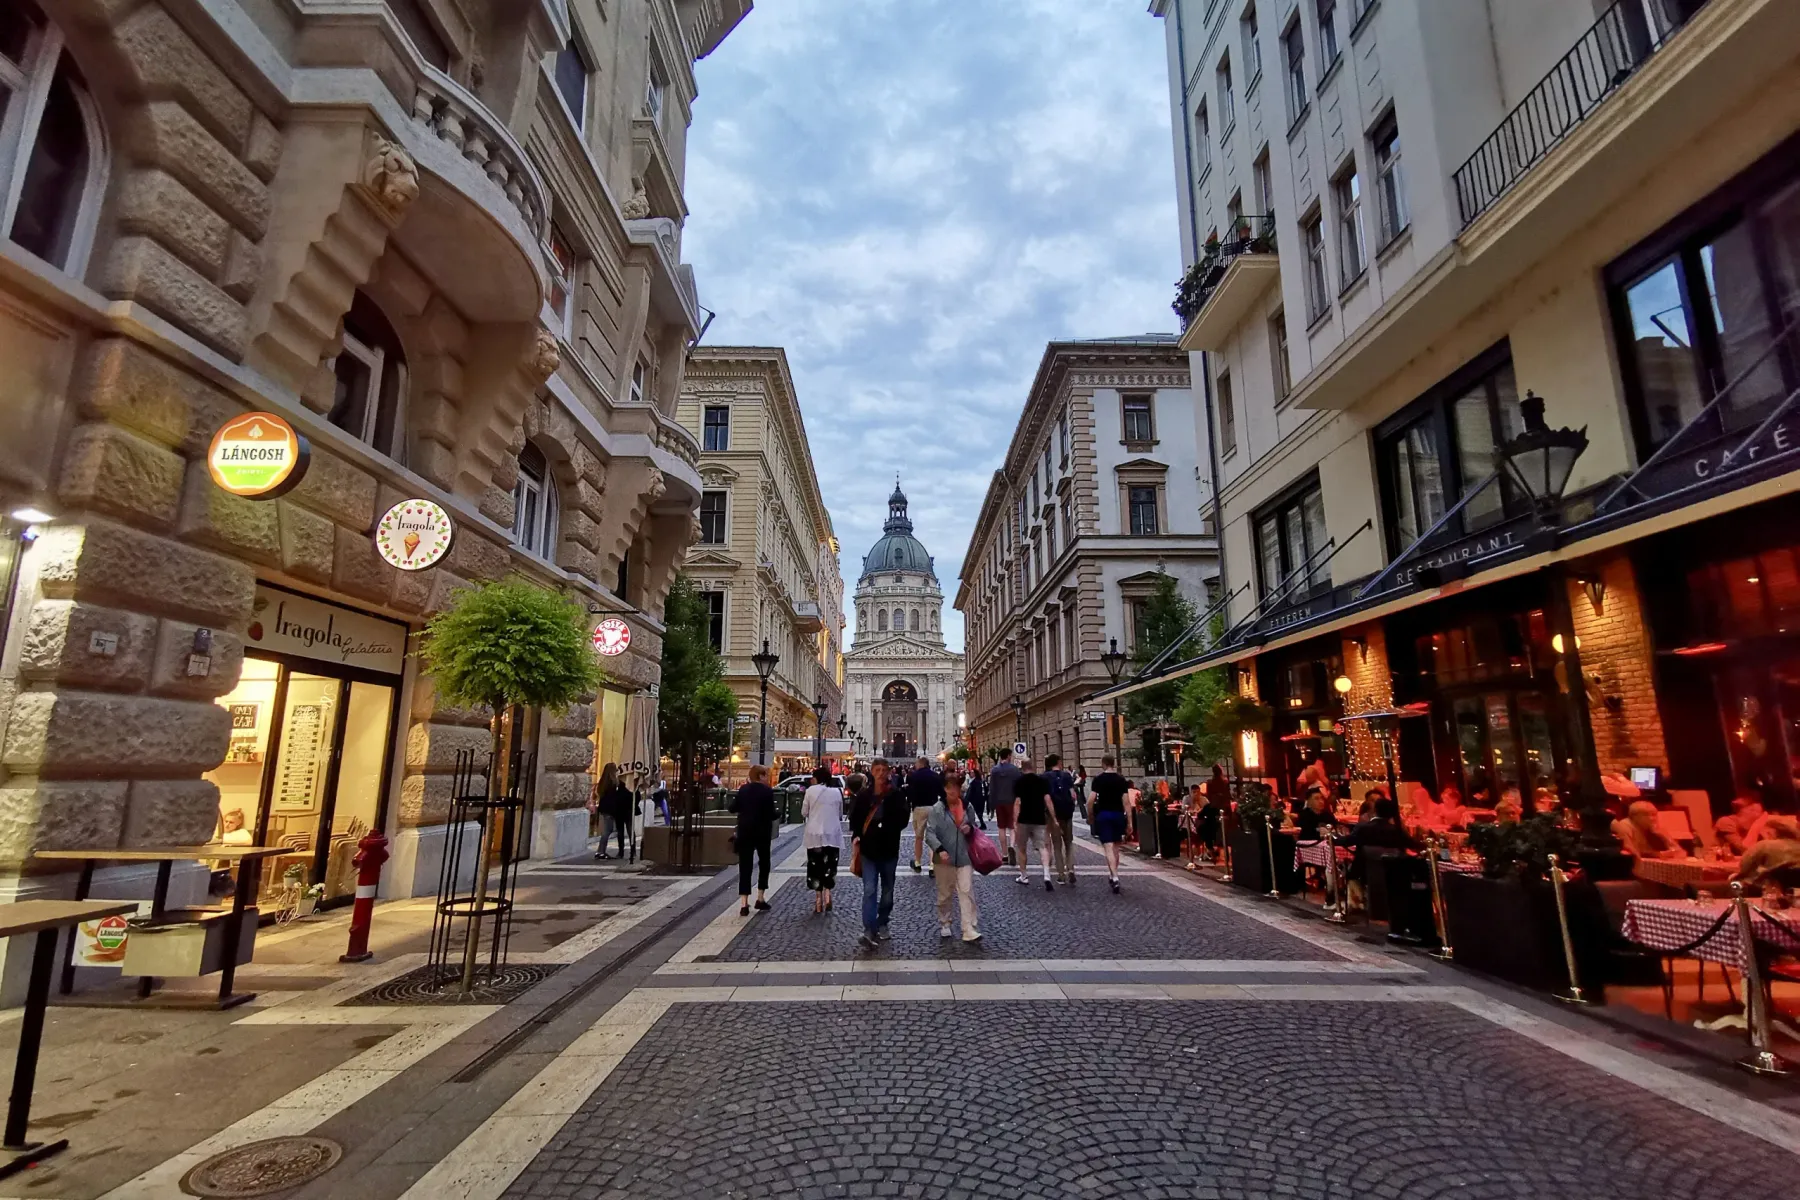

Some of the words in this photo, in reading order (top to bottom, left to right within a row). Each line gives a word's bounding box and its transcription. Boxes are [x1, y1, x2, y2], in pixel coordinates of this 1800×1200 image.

[221, 444, 285, 461] LÁNGOSH
[1396, 531, 1513, 586] RESTAURANT
[599, 620, 625, 631] COSTA
[340, 637, 394, 661] Gelateria
[596, 640, 627, 654] COFFEE
[234, 706, 253, 715] ONLY
[233, 716, 254, 728] CASH
